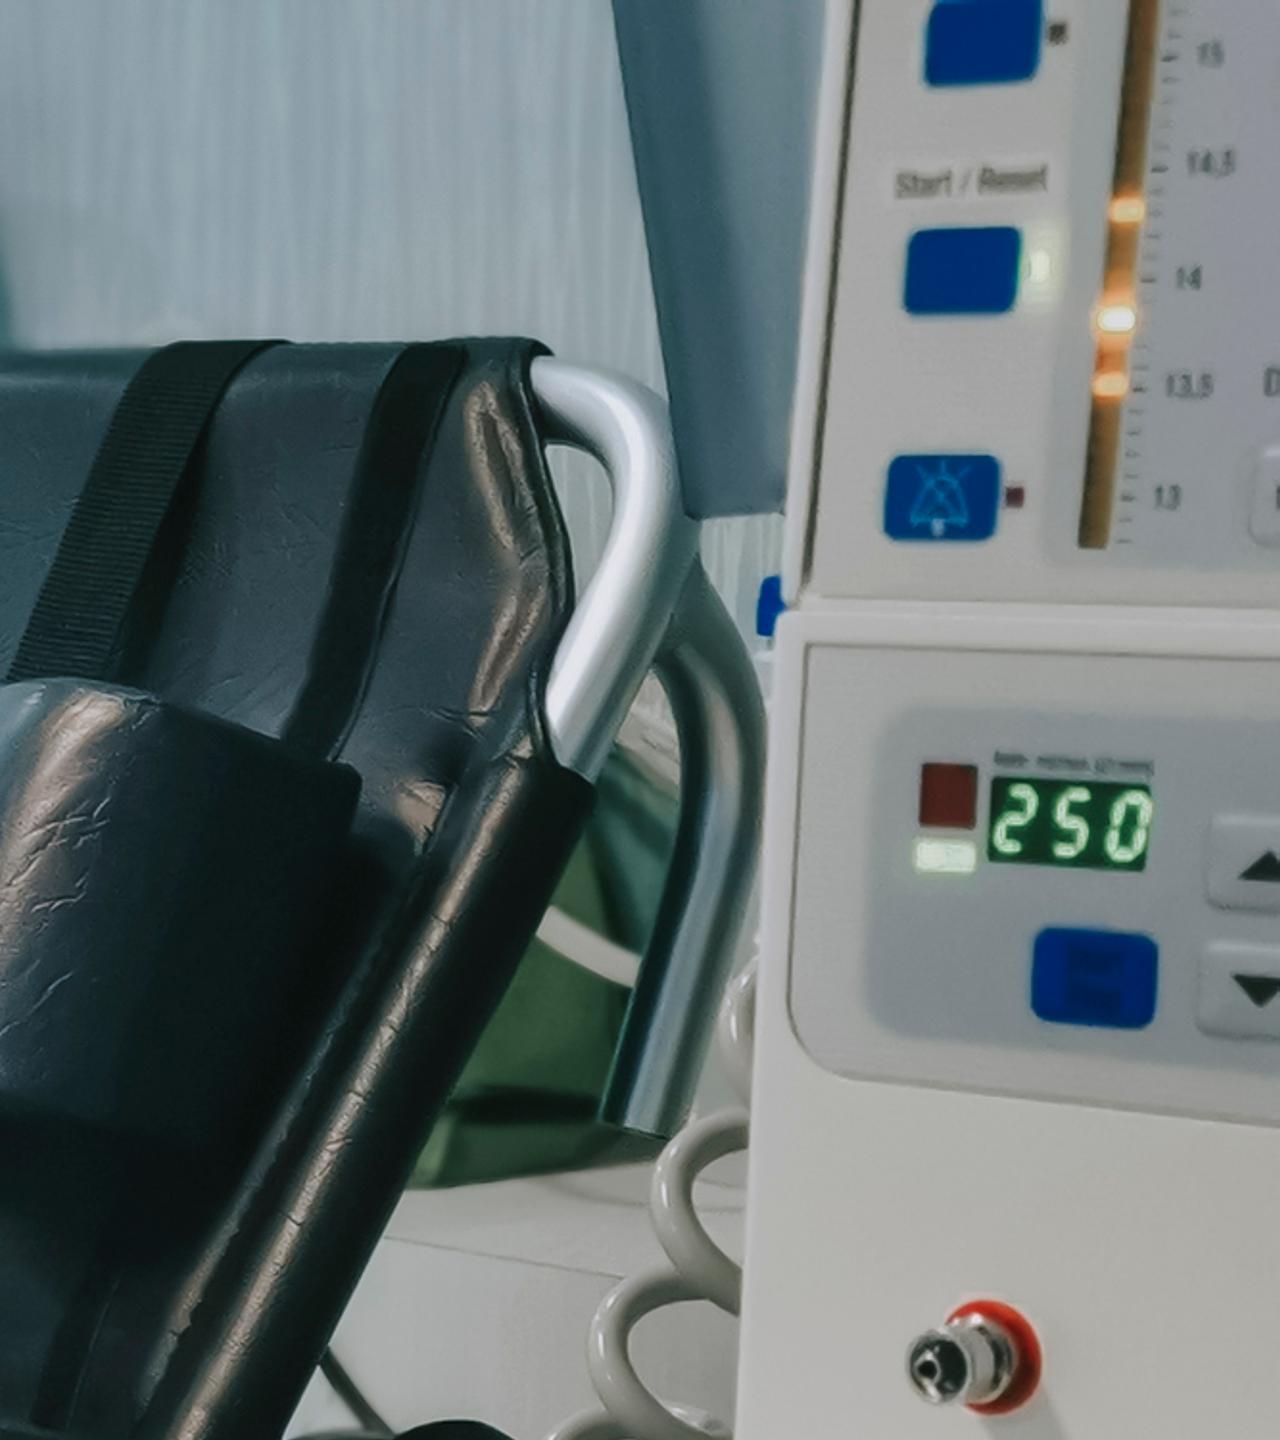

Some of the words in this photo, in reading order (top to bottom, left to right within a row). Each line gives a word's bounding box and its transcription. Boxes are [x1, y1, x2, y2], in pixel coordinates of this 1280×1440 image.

[896, 169, 952, 199] Start
[1176, 265, 1202, 290] 14
[1155, 484, 1182, 511] 13
[993, 783, 1153, 863] 250
